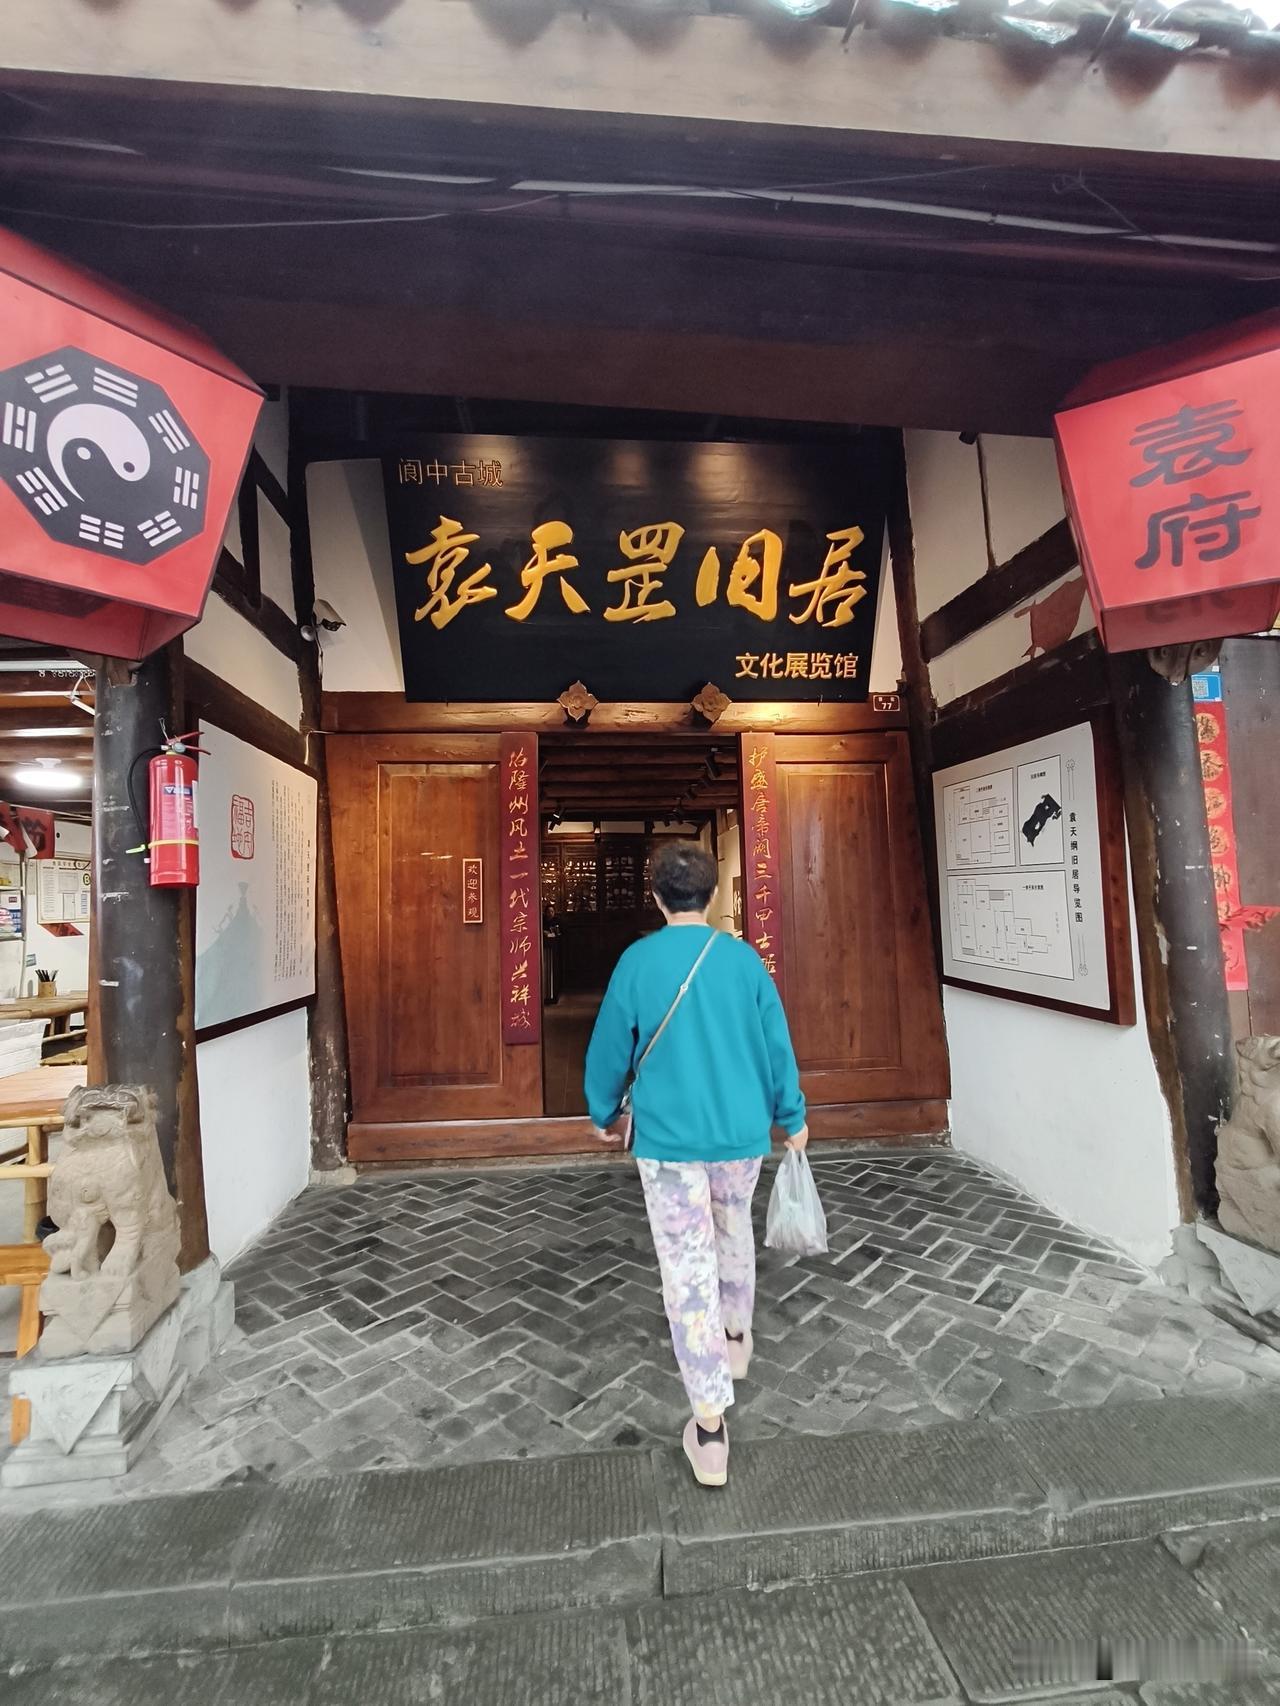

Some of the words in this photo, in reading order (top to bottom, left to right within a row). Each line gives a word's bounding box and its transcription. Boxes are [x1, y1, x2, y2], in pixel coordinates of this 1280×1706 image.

[398, 457, 504, 489] 阆中古城
[1129, 398, 1262, 570] 袁府
[404, 514, 869, 630] 袁天罡旧居
[735, 651, 860, 681] 文化展览馆
[881, 702, 893, 710] 77
